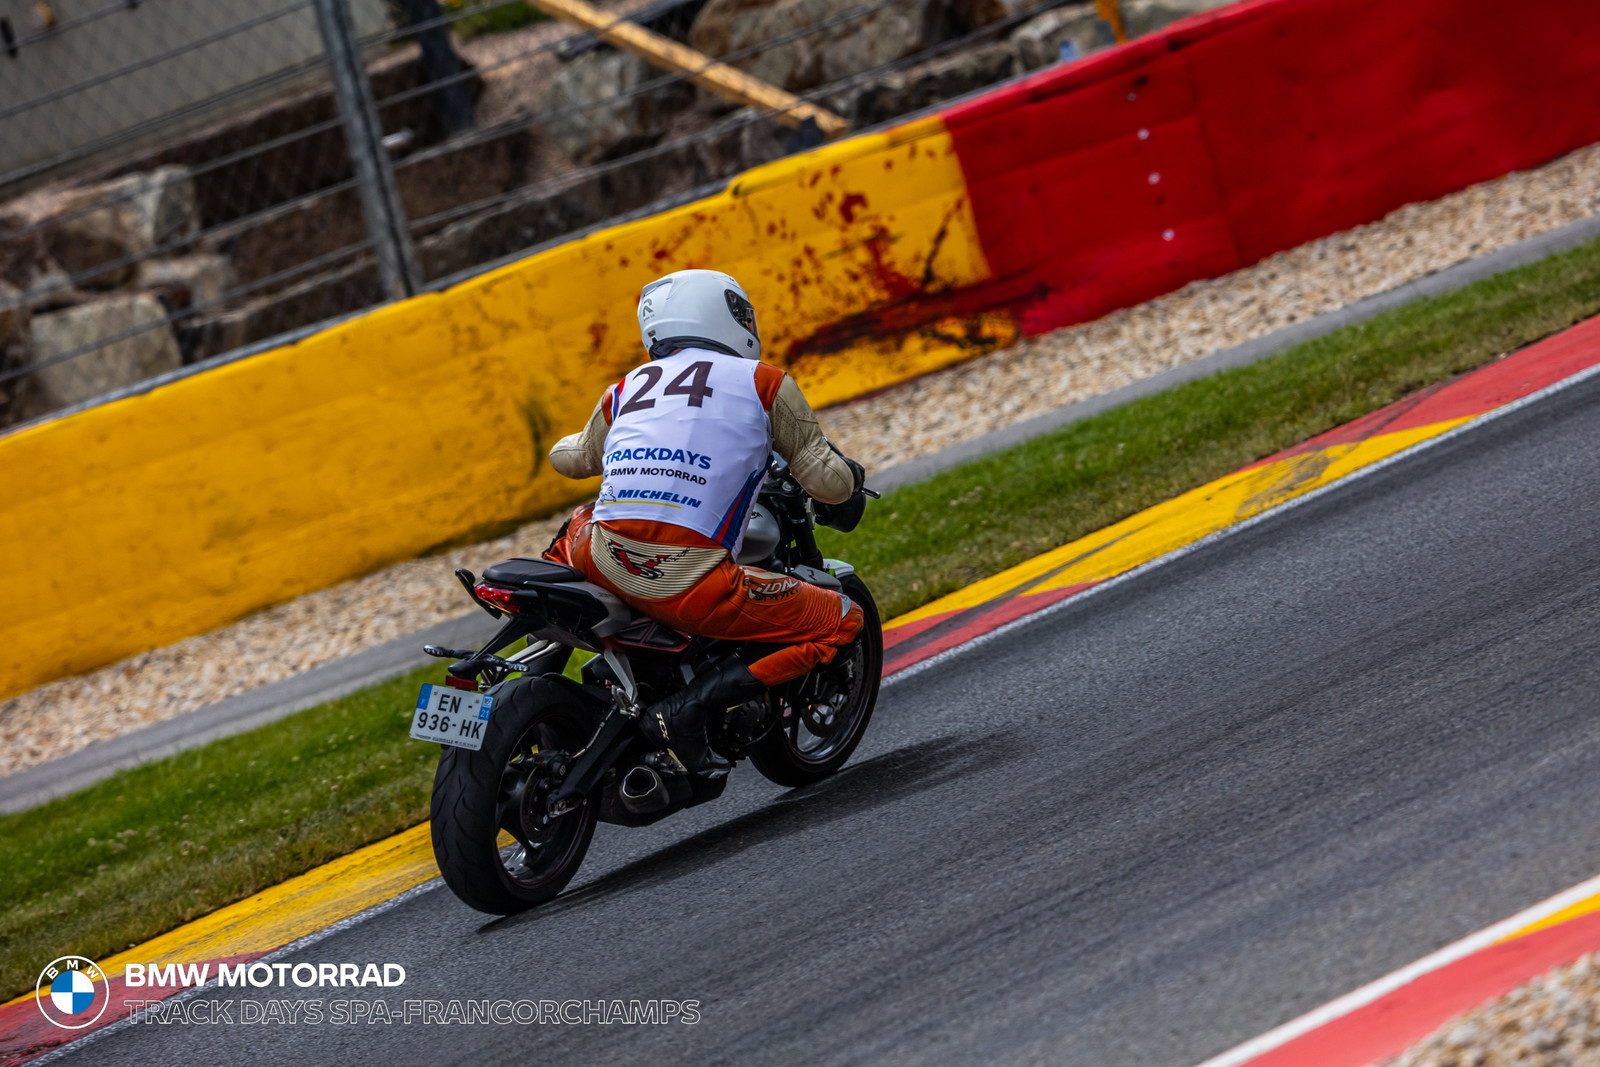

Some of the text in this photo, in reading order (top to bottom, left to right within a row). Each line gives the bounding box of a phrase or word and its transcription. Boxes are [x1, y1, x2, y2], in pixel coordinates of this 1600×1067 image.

[618, 361, 714, 417] 24
[606, 448, 712, 470] TRACKDAYS
[610, 467, 707, 486] BMW MOTORRAD
[617, 489, 702, 508] MICHELIN
[438, 694, 462, 714] EN
[480, 709, 490, 718] 21
